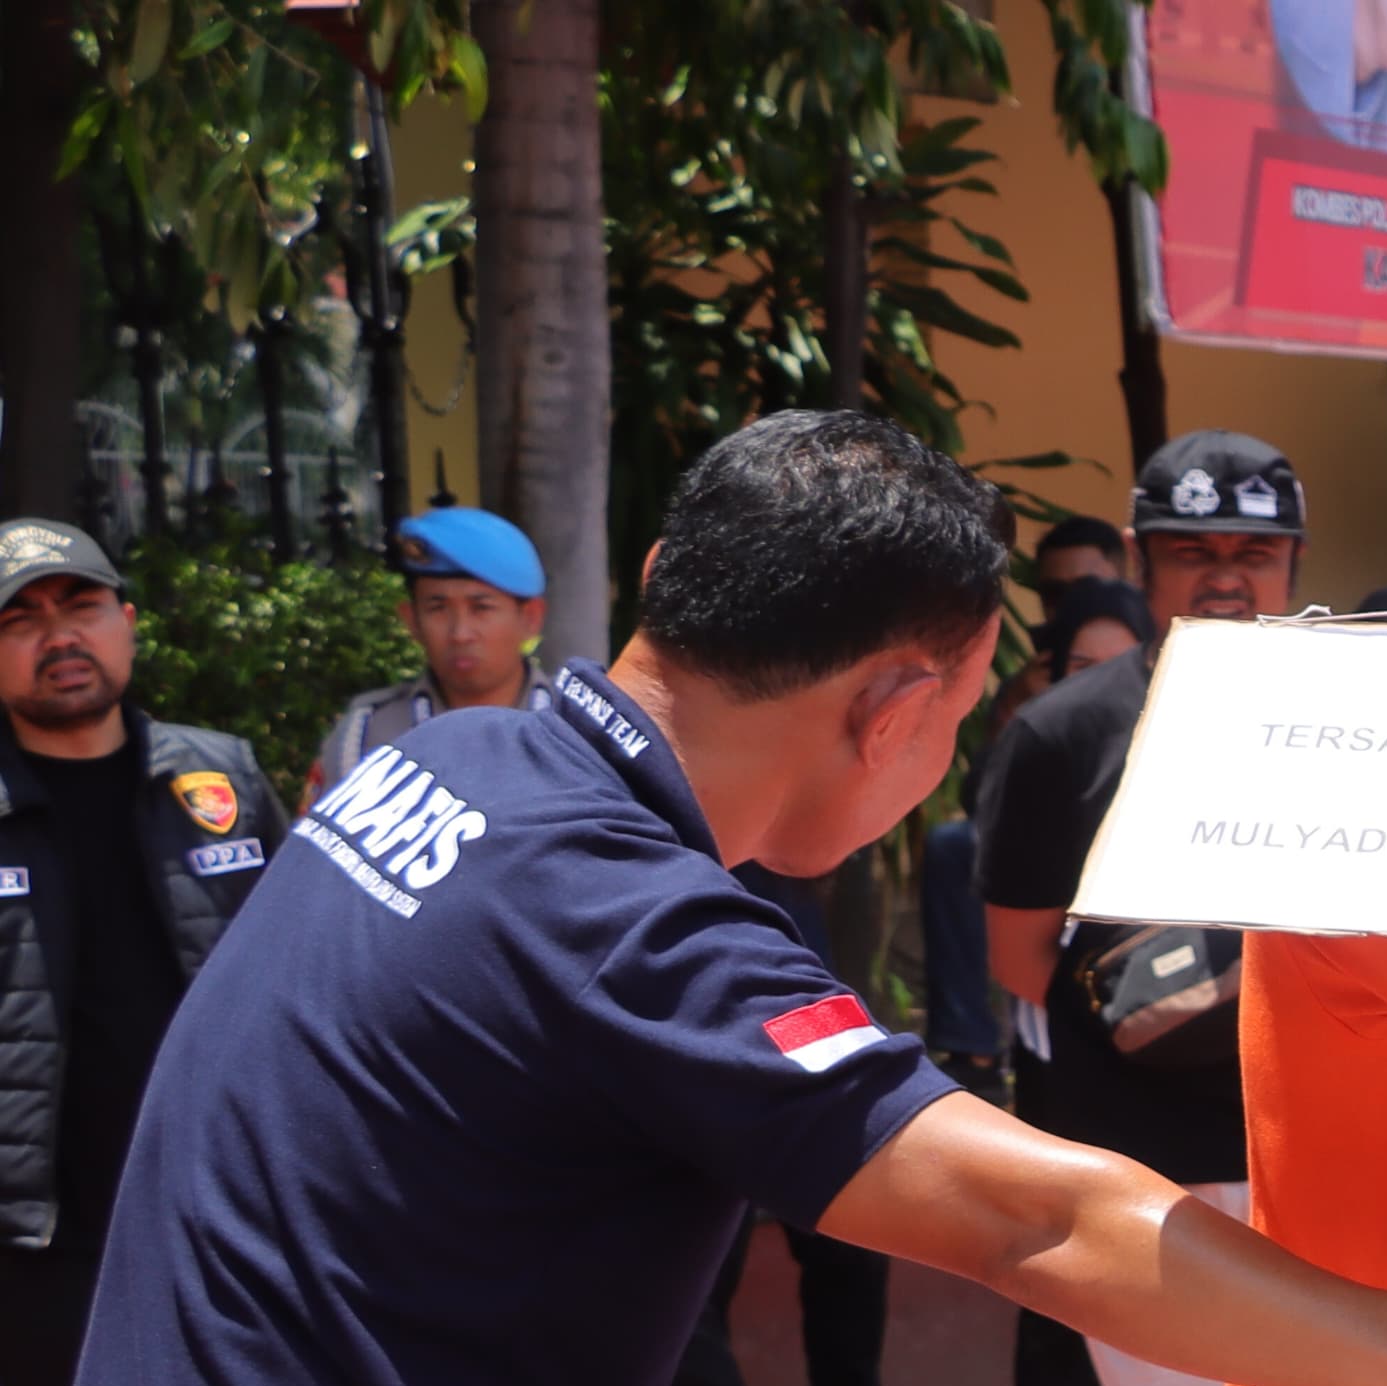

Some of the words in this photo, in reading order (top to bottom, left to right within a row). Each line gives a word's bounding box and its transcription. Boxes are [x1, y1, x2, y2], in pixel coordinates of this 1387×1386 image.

[605, 712, 650, 758] TEAM
[312, 745, 487, 889] INAFIS
[203, 845, 254, 868] PPA
